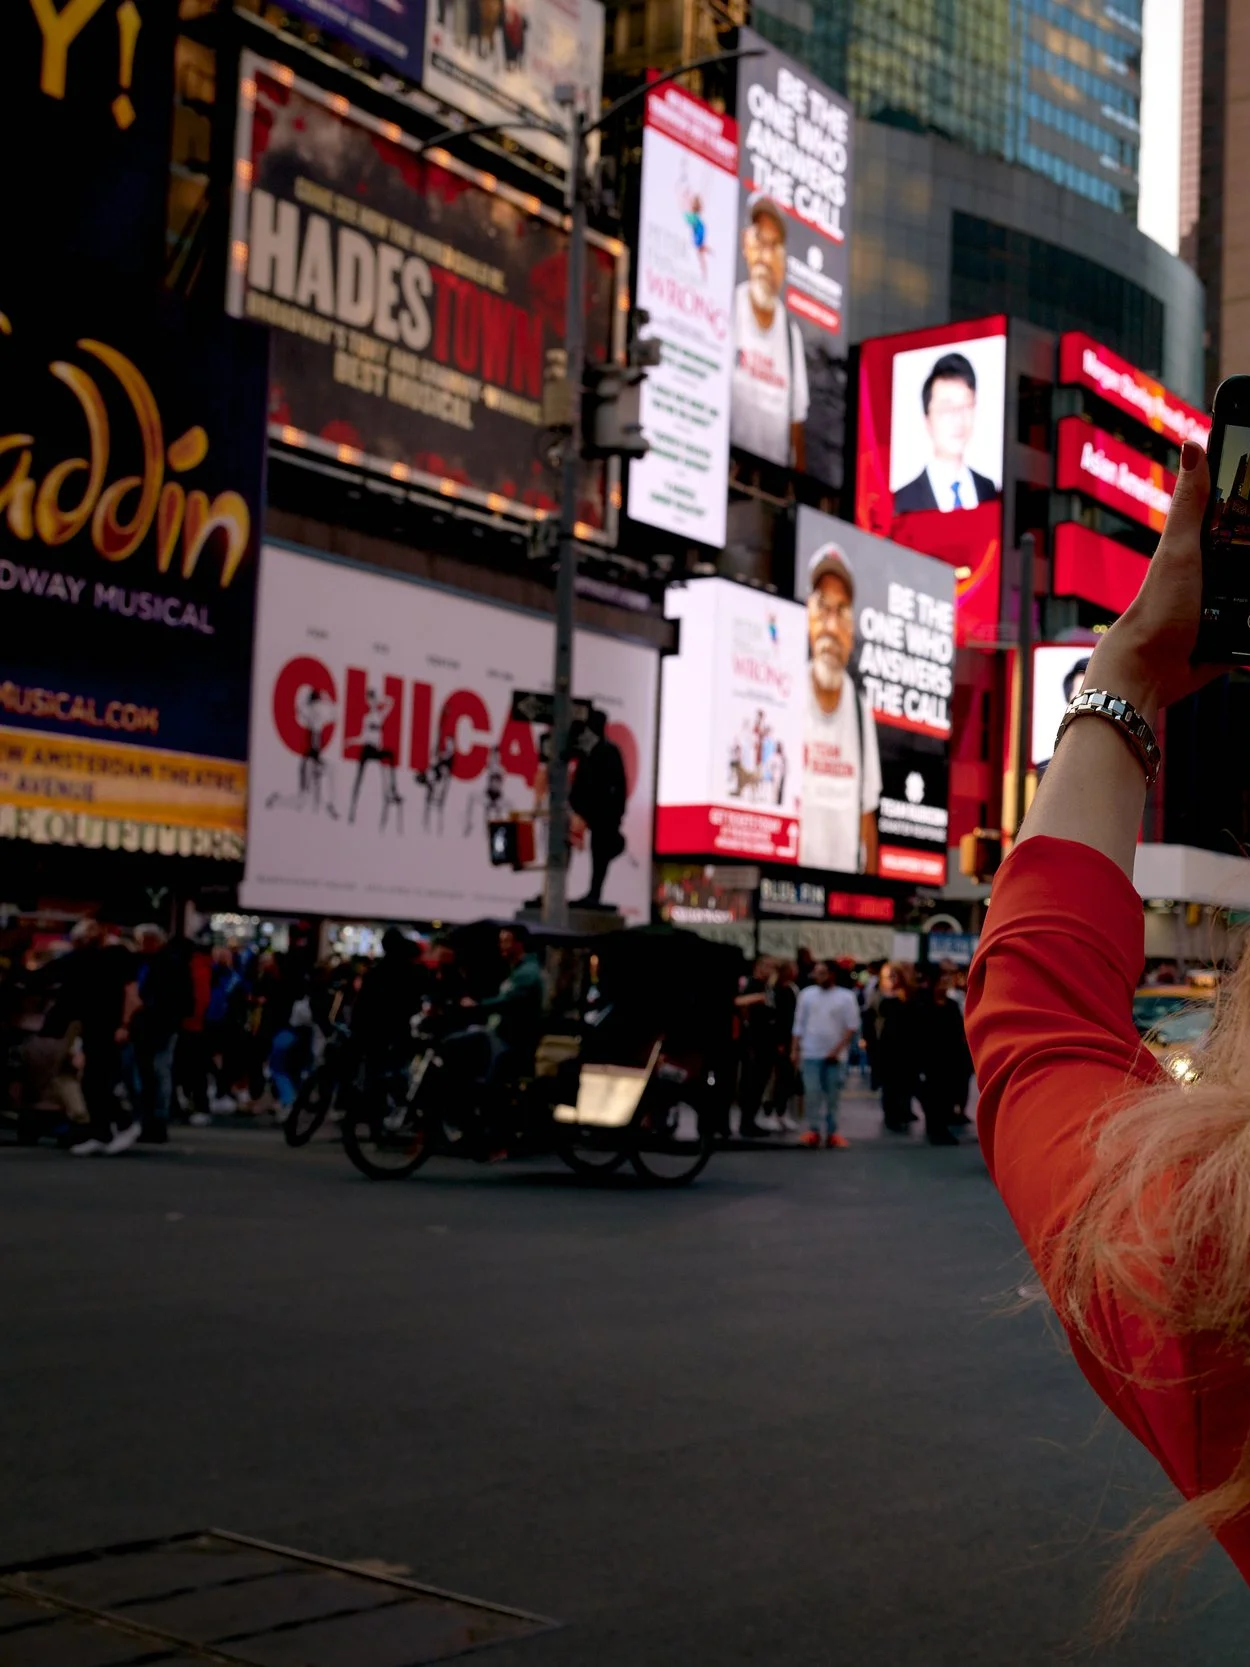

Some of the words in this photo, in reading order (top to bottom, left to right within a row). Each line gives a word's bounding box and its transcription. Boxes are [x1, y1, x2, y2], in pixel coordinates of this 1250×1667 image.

[747, 83, 796, 138] ONE
[796, 115, 848, 173] WHO
[745, 120, 846, 206] ANSWERS
[794, 184, 845, 241] CALL
[93, 581, 216, 635] MUSICAL
[860, 606, 905, 649] ONE
[905, 621, 953, 664] WHO
[888, 581, 915, 620] BE
[916, 592, 954, 634] THE
[858, 641, 952, 698] ANSWERS
[273, 656, 639, 802] CHICA
[863, 676, 904, 717] THE
[904, 688, 951, 730] CALL
